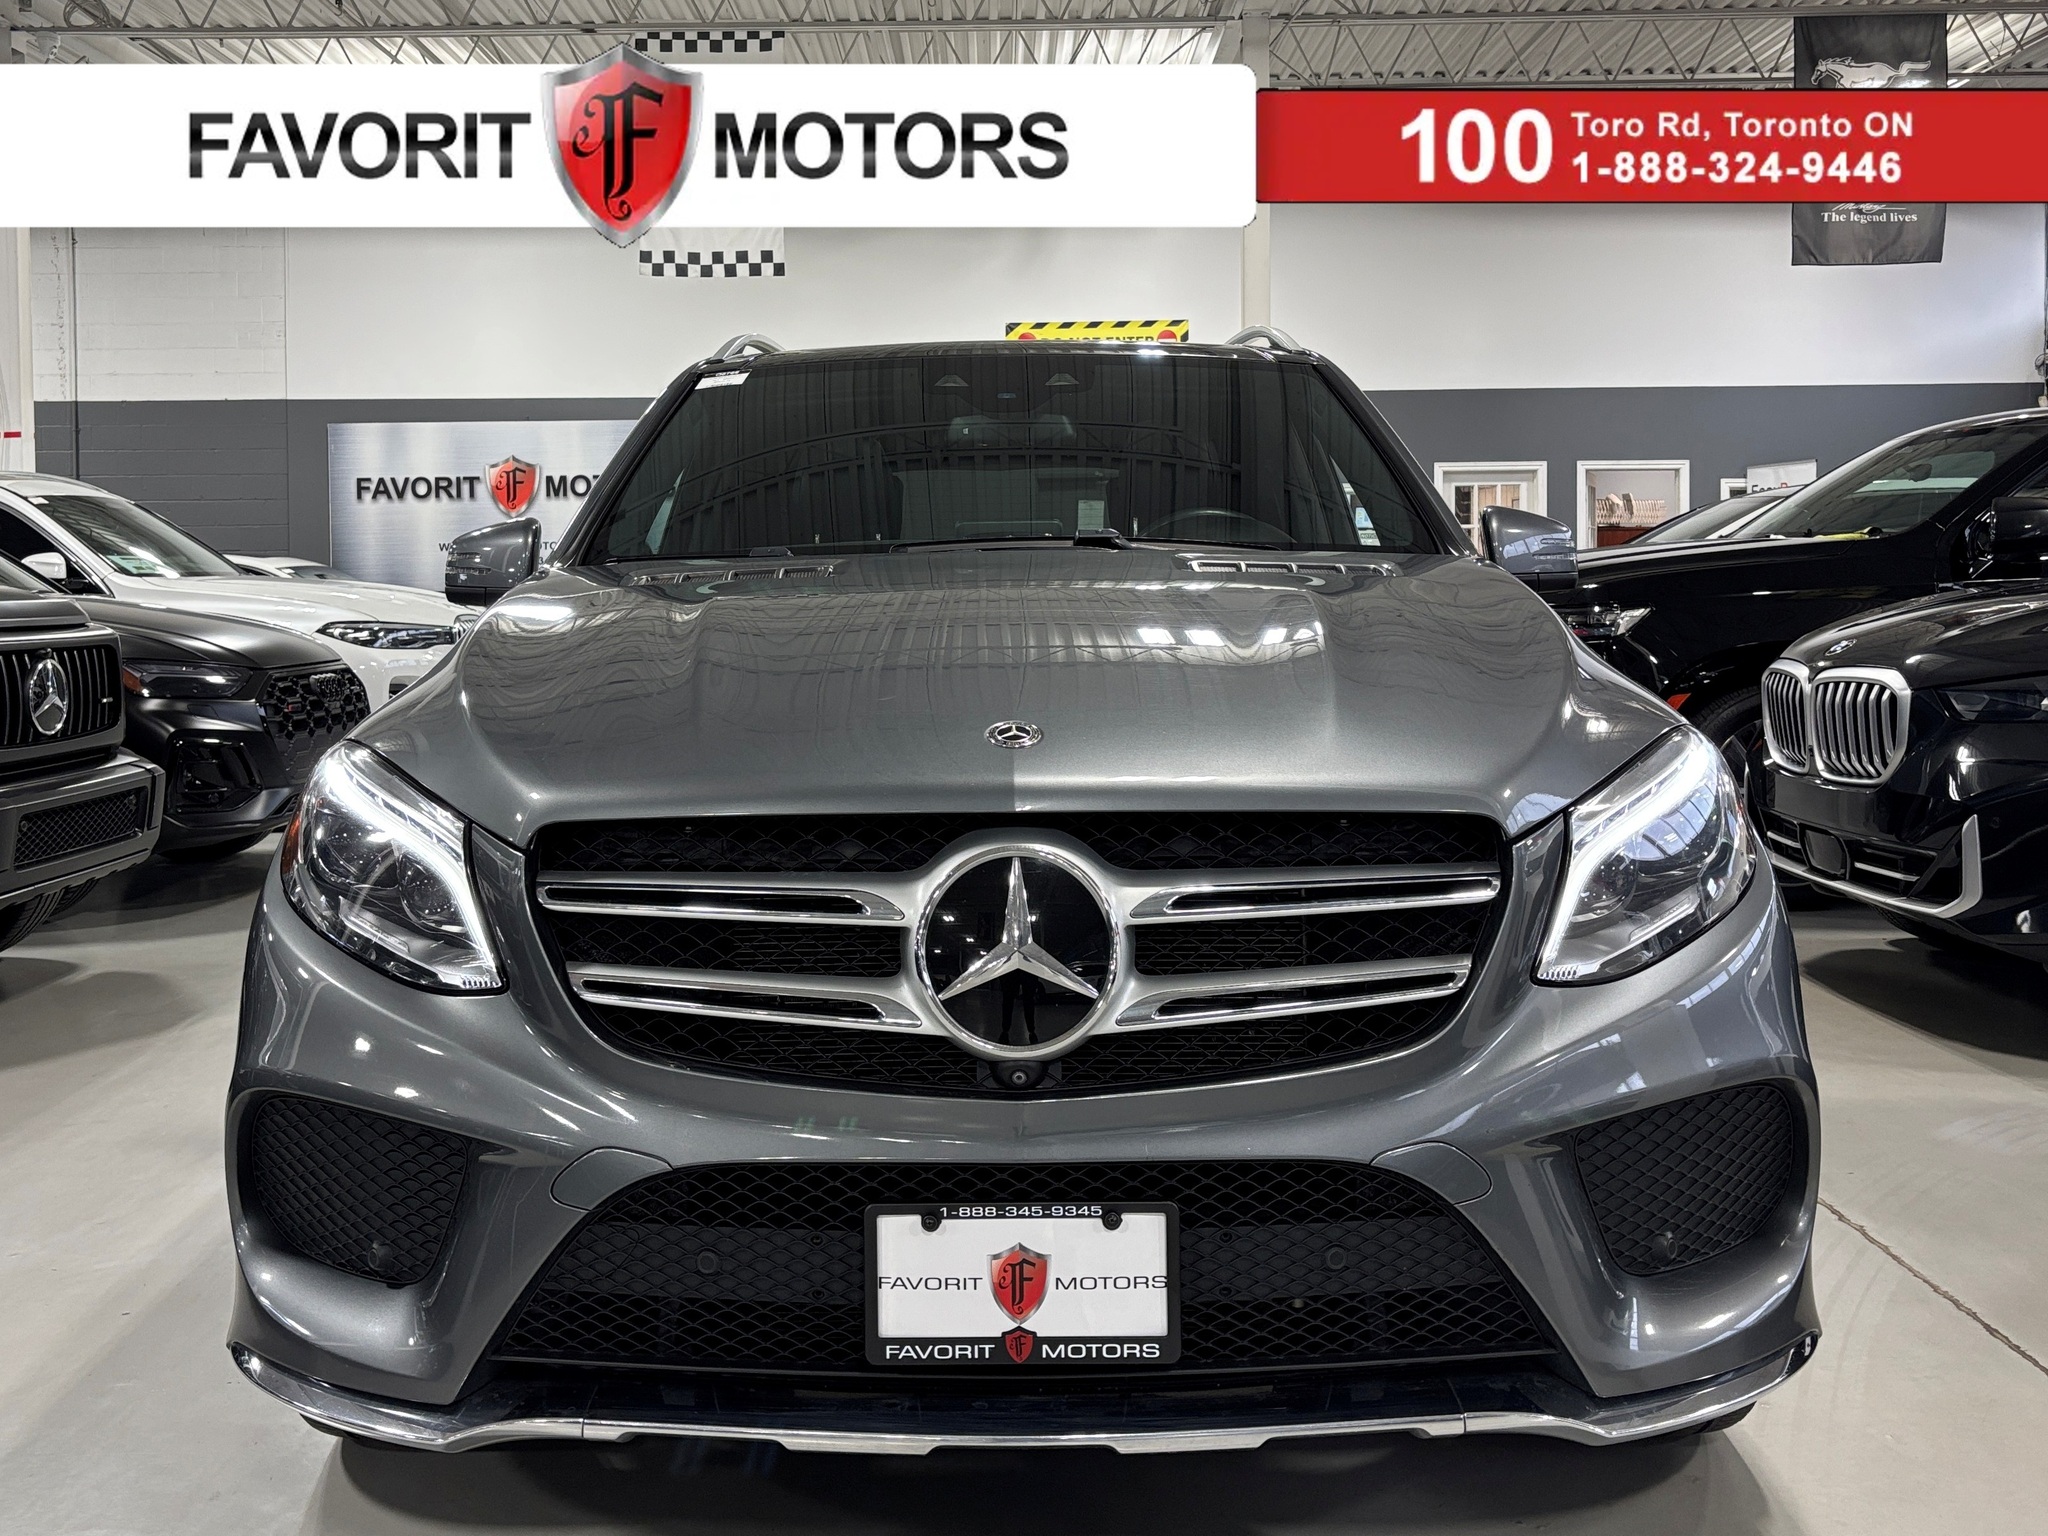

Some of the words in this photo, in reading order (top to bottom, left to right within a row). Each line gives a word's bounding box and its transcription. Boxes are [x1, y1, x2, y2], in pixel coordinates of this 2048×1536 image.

[1822, 212, 1847, 222] The
[1850, 211, 1887, 224] legend
[1890, 212, 1918, 222] lives
[356, 476, 480, 499] FAVORIT
[939, 1206, 1103, 1217] 1-888-345-9345
[879, 1276, 983, 1291] FAVORIT
[1055, 1275, 1168, 1290] MOTORS
[886, 1344, 995, 1360] FAVORIT
[1042, 1343, 1160, 1359] MOTORS
